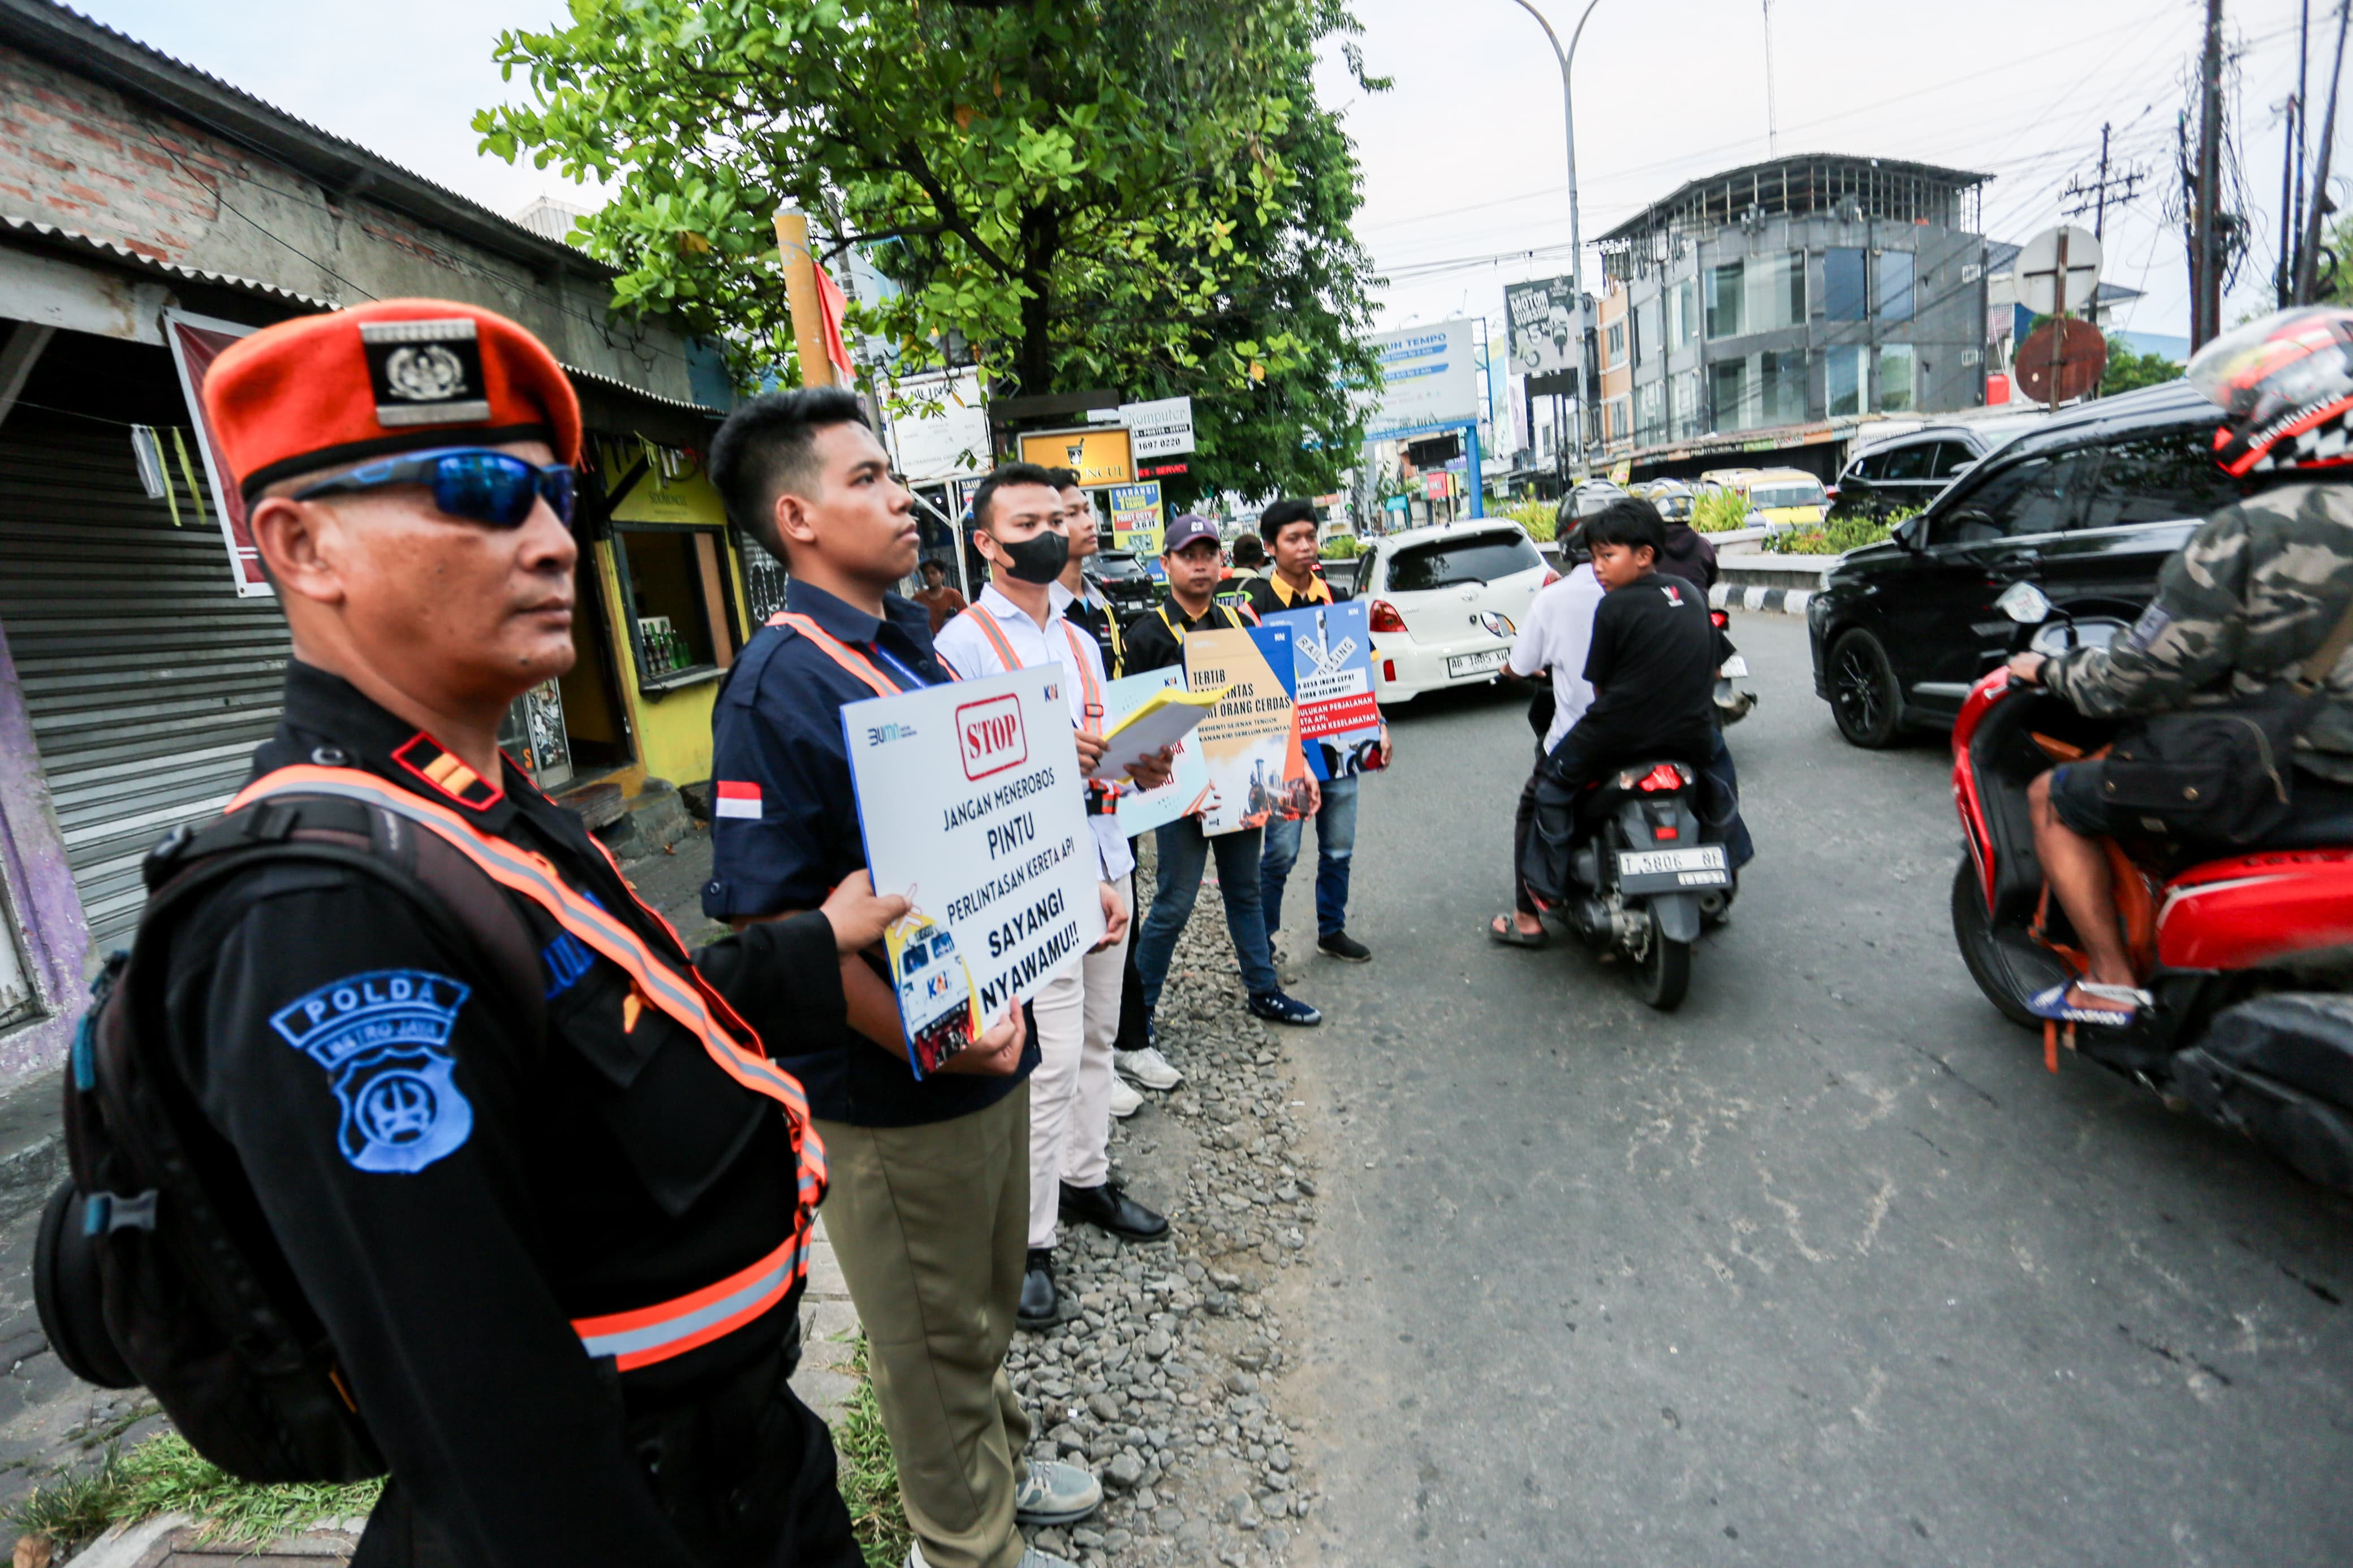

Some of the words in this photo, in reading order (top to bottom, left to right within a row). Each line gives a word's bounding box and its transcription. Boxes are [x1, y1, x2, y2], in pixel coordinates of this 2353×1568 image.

[1406, 332, 1446, 346] TEMPO
[1528, 323, 1542, 345] 5
[1128, 408, 1185, 426] Komputer
[1160, 437, 1180, 447] 0220
[1080, 465, 1124, 480] UNCUL
[1116, 486, 1156, 498] GARANSI
[1164, 676, 1177, 688] KAI
[1193, 669, 1225, 686] TERTIB
[1043, 684, 1058, 703] KAI
[1300, 691, 1316, 700] TIDAK
[1221, 701, 1252, 717] ORANG
[1255, 696, 1290, 712] CERDAS
[1298, 704, 1328, 717] ULUKAN
[1329, 696, 1373, 712] PERJALANAN
[1198, 724, 1226, 733] BERHENTI
[1300, 716, 1313, 726] ETA
[1300, 722, 1326, 735] MAKAN
[1328, 713, 1376, 729] KESELAMATAN
[966, 714, 1016, 759] STOP
[1199, 735, 1221, 743] KANAN
[1235, 729, 1261, 738] SEBELUM
[944, 792, 993, 832] JANGAN
[993, 767, 1055, 810] MENEROBOS
[986, 811, 1035, 861] PINTU
[946, 864, 1026, 926] PERLINTASAN
[1025, 845, 1060, 881] KERETA
[1061, 835, 1075, 861] API
[988, 887, 1065, 959] SAYANGI
[980, 920, 1080, 1015] NYAWAMU!!
[926, 970, 949, 1000] KAI
[304, 978, 436, 1025] POLDA
